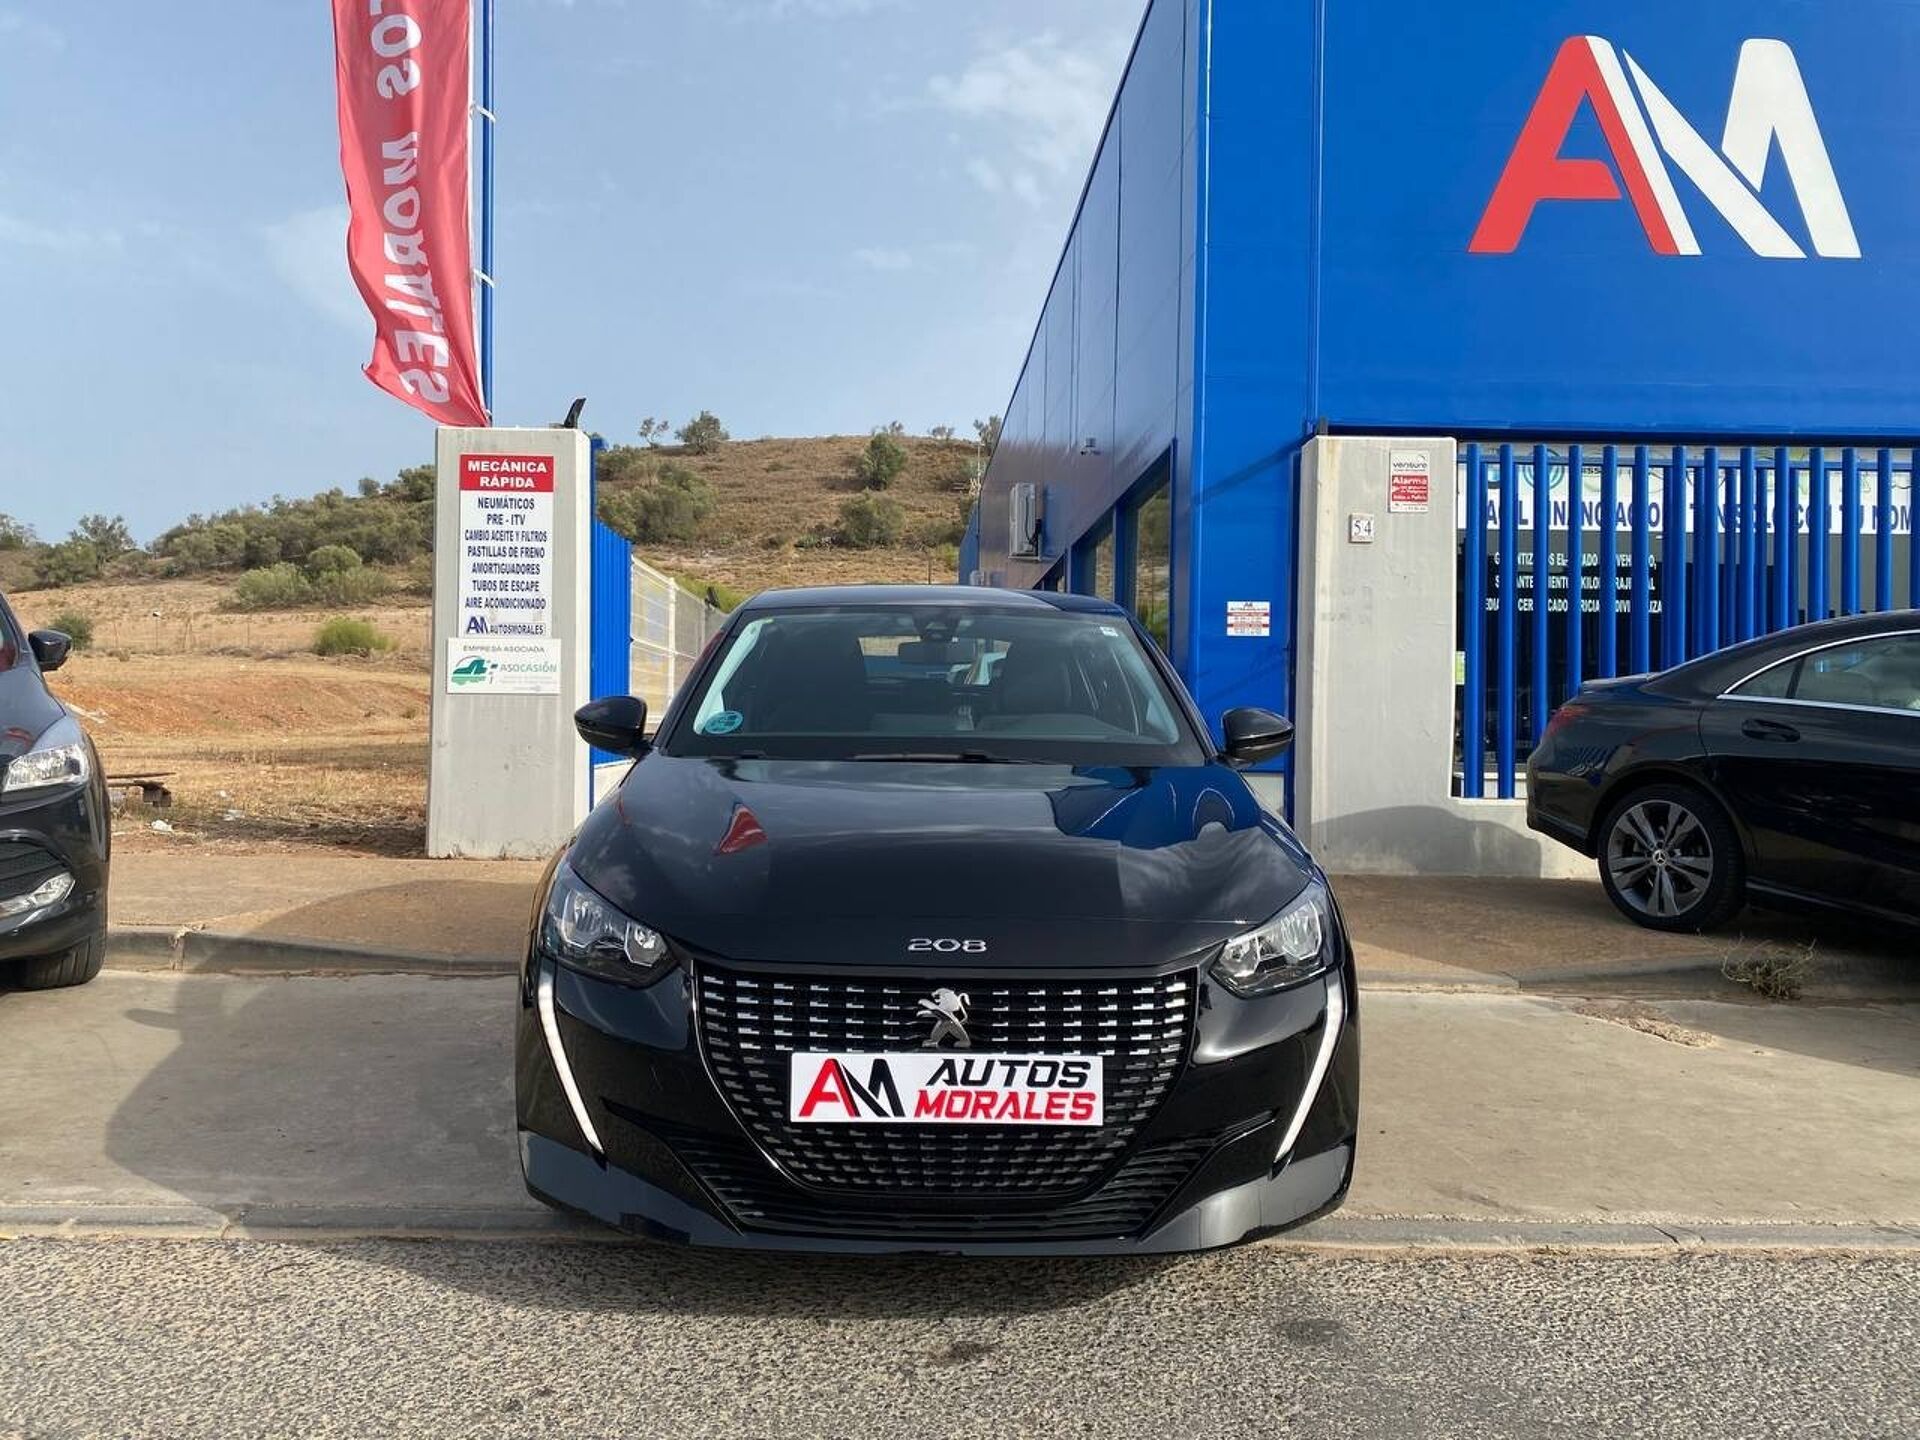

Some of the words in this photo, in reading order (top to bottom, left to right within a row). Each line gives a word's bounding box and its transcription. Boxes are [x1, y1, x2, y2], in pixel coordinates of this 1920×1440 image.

[1468, 35, 1862, 259] AM
[467, 459, 547, 473] MECÁNICA
[480, 474, 535, 488] RÁPIDA
[477, 494, 535, 510] NEUMÁTICOS
[486, 513, 503, 525] PRE
[511, 514, 526, 525] ITV
[1354, 519, 1372, 536] 54
[464, 529, 489, 541] CAMBIO
[491, 530, 514, 541] ACEITE
[515, 530, 520, 541] Y
[521, 530, 548, 542] FILTROS
[467, 545, 507, 557] PASTILLAS
[508, 546, 518, 558] DE
[520, 547, 545, 558] FRENO
[471, 562, 541, 575] AMORTIGUADORES
[472, 580, 497, 592] TUBOS
[499, 580, 509, 592] DE
[511, 580, 540, 592] ESCAPE
[465, 597, 482, 608] AIRE
[484, 597, 546, 609] ACONDICIONADO
[907, 938, 987, 952] 208
[925, 1058, 1092, 1088] AUTOS
[913, 1089, 1097, 1121] MORALES
